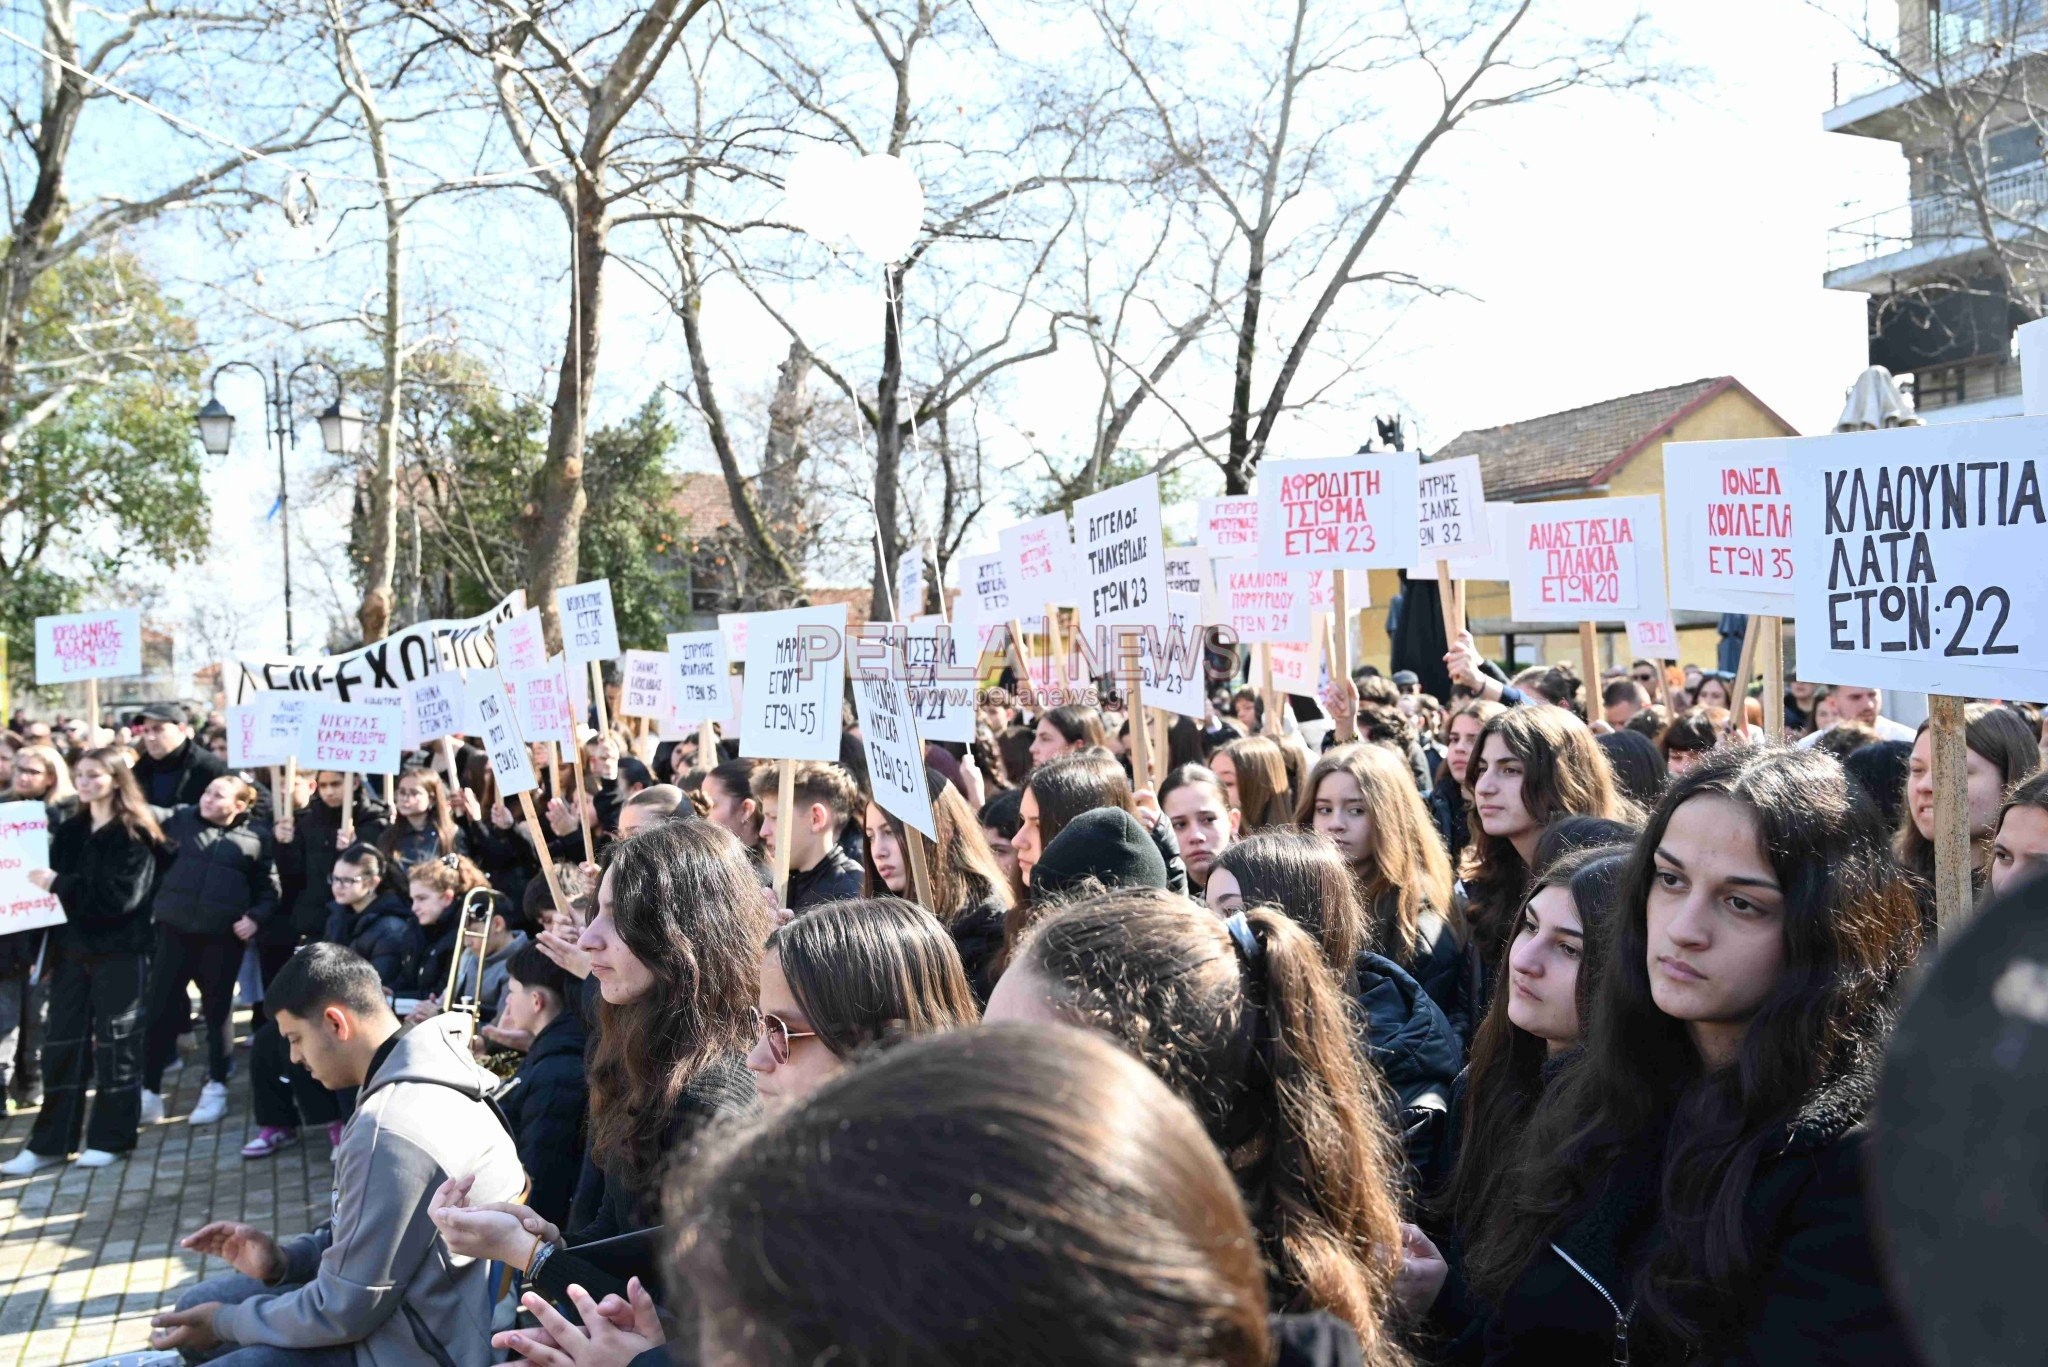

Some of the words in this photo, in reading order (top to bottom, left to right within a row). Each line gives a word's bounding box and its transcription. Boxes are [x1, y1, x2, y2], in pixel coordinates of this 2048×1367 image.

[1280, 470, 1380, 502] ΑΦΡΟΔΙΤΗ
[1420, 474, 1458, 498] ΗΤΡΗΣ
[1722, 467, 1781, 496] ΙΟΝΕΛ
[1216, 502, 1257, 515] ΓΙΩΡΓΟ
[1420, 498, 1461, 522] ΣΑΛΗΣ
[1824, 460, 2047, 535] ΚΛΑΟΥΝΤΙΑ
[1090, 507, 1138, 543] ΑΓΓΕΛΟΣ
[1283, 498, 1367, 528] ΤΣΙΩΜΑ
[1285, 526, 1340, 556] ΕΤΩΝ
[1345, 524, 1376, 552] 23
[1420, 526, 1435, 546] ΩΝ
[1442, 522, 1461, 543] 32
[1529, 518, 1633, 550] ΑΝΑΣΤΑΣΙΑ
[1088, 536, 1147, 575] ΤΗΛΚΕΡΙΔΗΣ
[1547, 545, 1619, 575] ΠΛΑΚΙΑ
[1709, 546, 1763, 577] ΕΤΩΝ
[1771, 547, 1794, 579] 35
[1828, 532, 1937, 590] ΛΑΤΑ
[1230, 571, 1288, 590] ΚΑΛΛΙΟΠΗ
[1542, 575, 1593, 602] ΕΤΩΝ
[1596, 573, 1618, 603] 20
[1093, 580, 1129, 617] ΕΤΩΝ
[1131, 576, 1147, 607] 23
[1232, 615, 1266, 631] ΕΤΩΝ
[776, 637, 807, 664] ΜΑΡΙΑ
[769, 668, 803, 694] ΕΓΟΥΤ
[1167, 673, 1183, 694] 23
[764, 703, 797, 730] ΕΤΩΝ
[800, 702, 816, 735] 55
[926, 690, 946, 720] 21
[320, 714, 379, 729] ΝΙΚΗΤΑΣ
[317, 746, 353, 760] ΕΤΩΝ
[359, 749, 377, 762] 23
[871, 741, 898, 787] ΕΤΩΝ
[896, 758, 913, 793] 23
